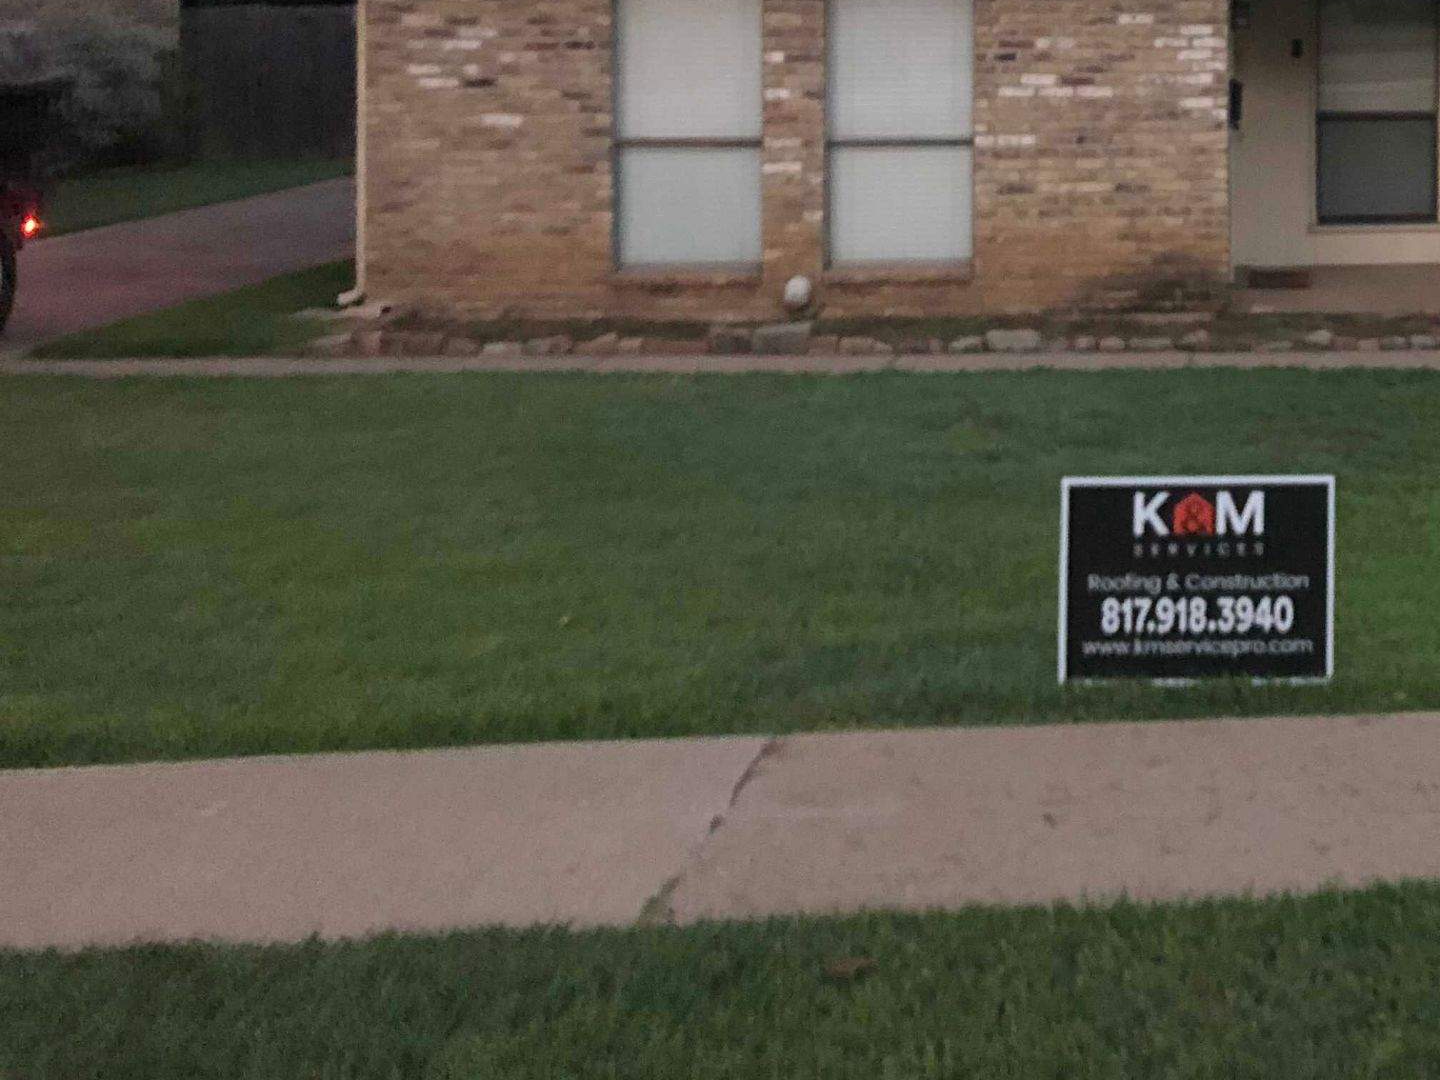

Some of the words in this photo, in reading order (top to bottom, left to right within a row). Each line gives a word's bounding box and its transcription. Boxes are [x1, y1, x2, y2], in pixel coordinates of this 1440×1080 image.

[1087, 573, 1162, 594] Roofing
[1166, 573, 1180, 591] &
[1184, 572, 1310, 591] Construction
[1100, 595, 1294, 634] 817.918.3940
